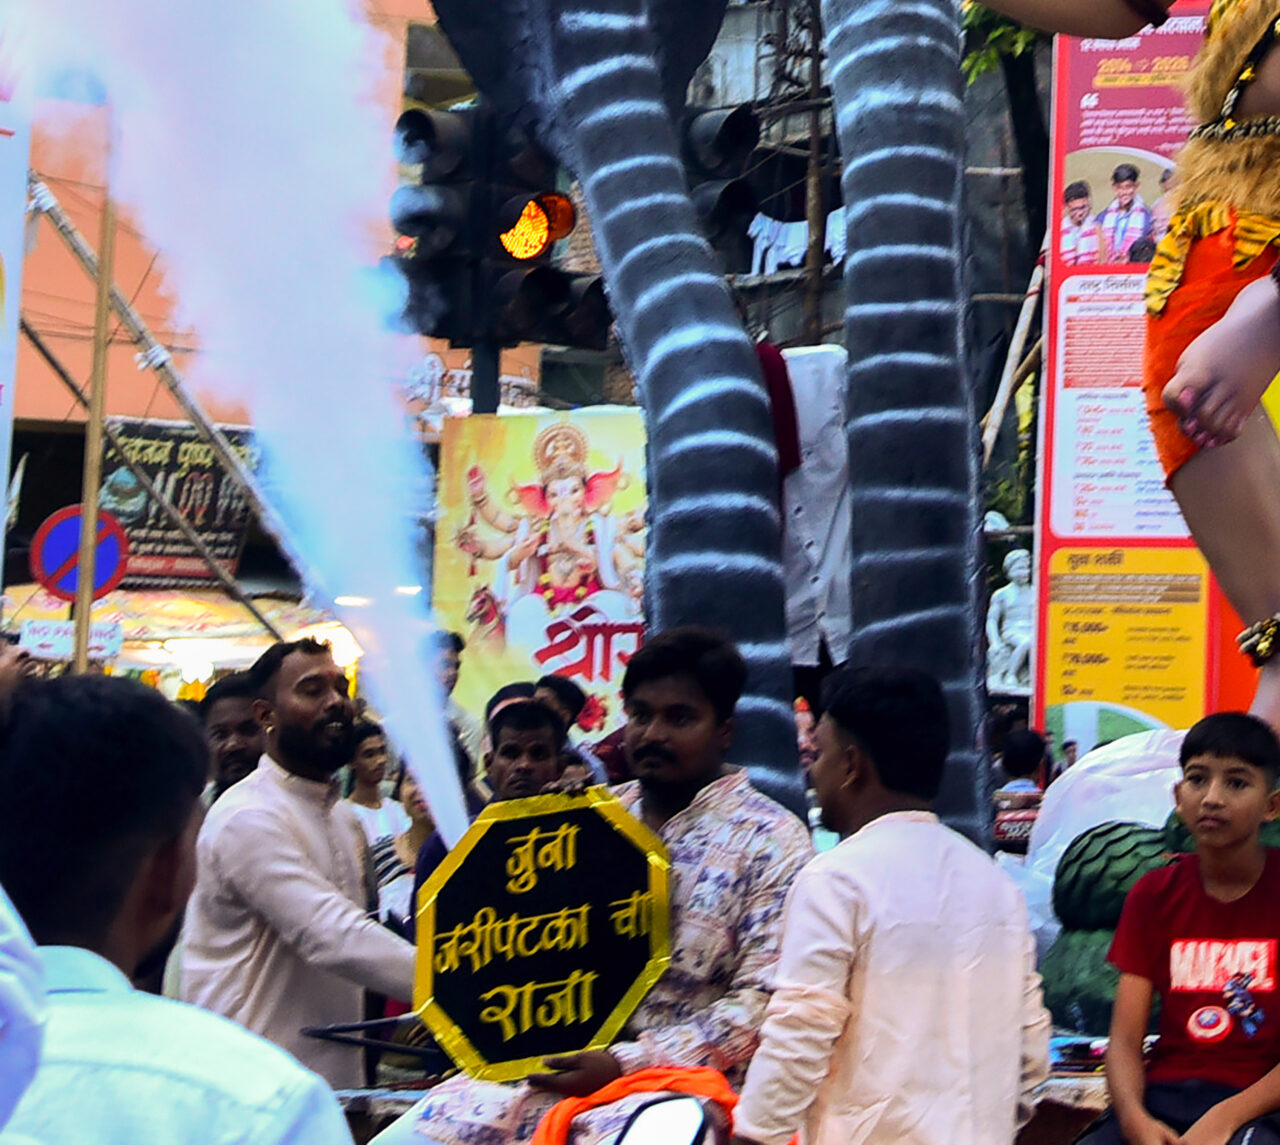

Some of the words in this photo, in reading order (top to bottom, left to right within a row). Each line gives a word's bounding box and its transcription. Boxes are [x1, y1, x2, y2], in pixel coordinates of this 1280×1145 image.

[505, 822, 583, 894] जुना
[608, 889, 654, 939] चा
[478, 968, 600, 1043] राजा
